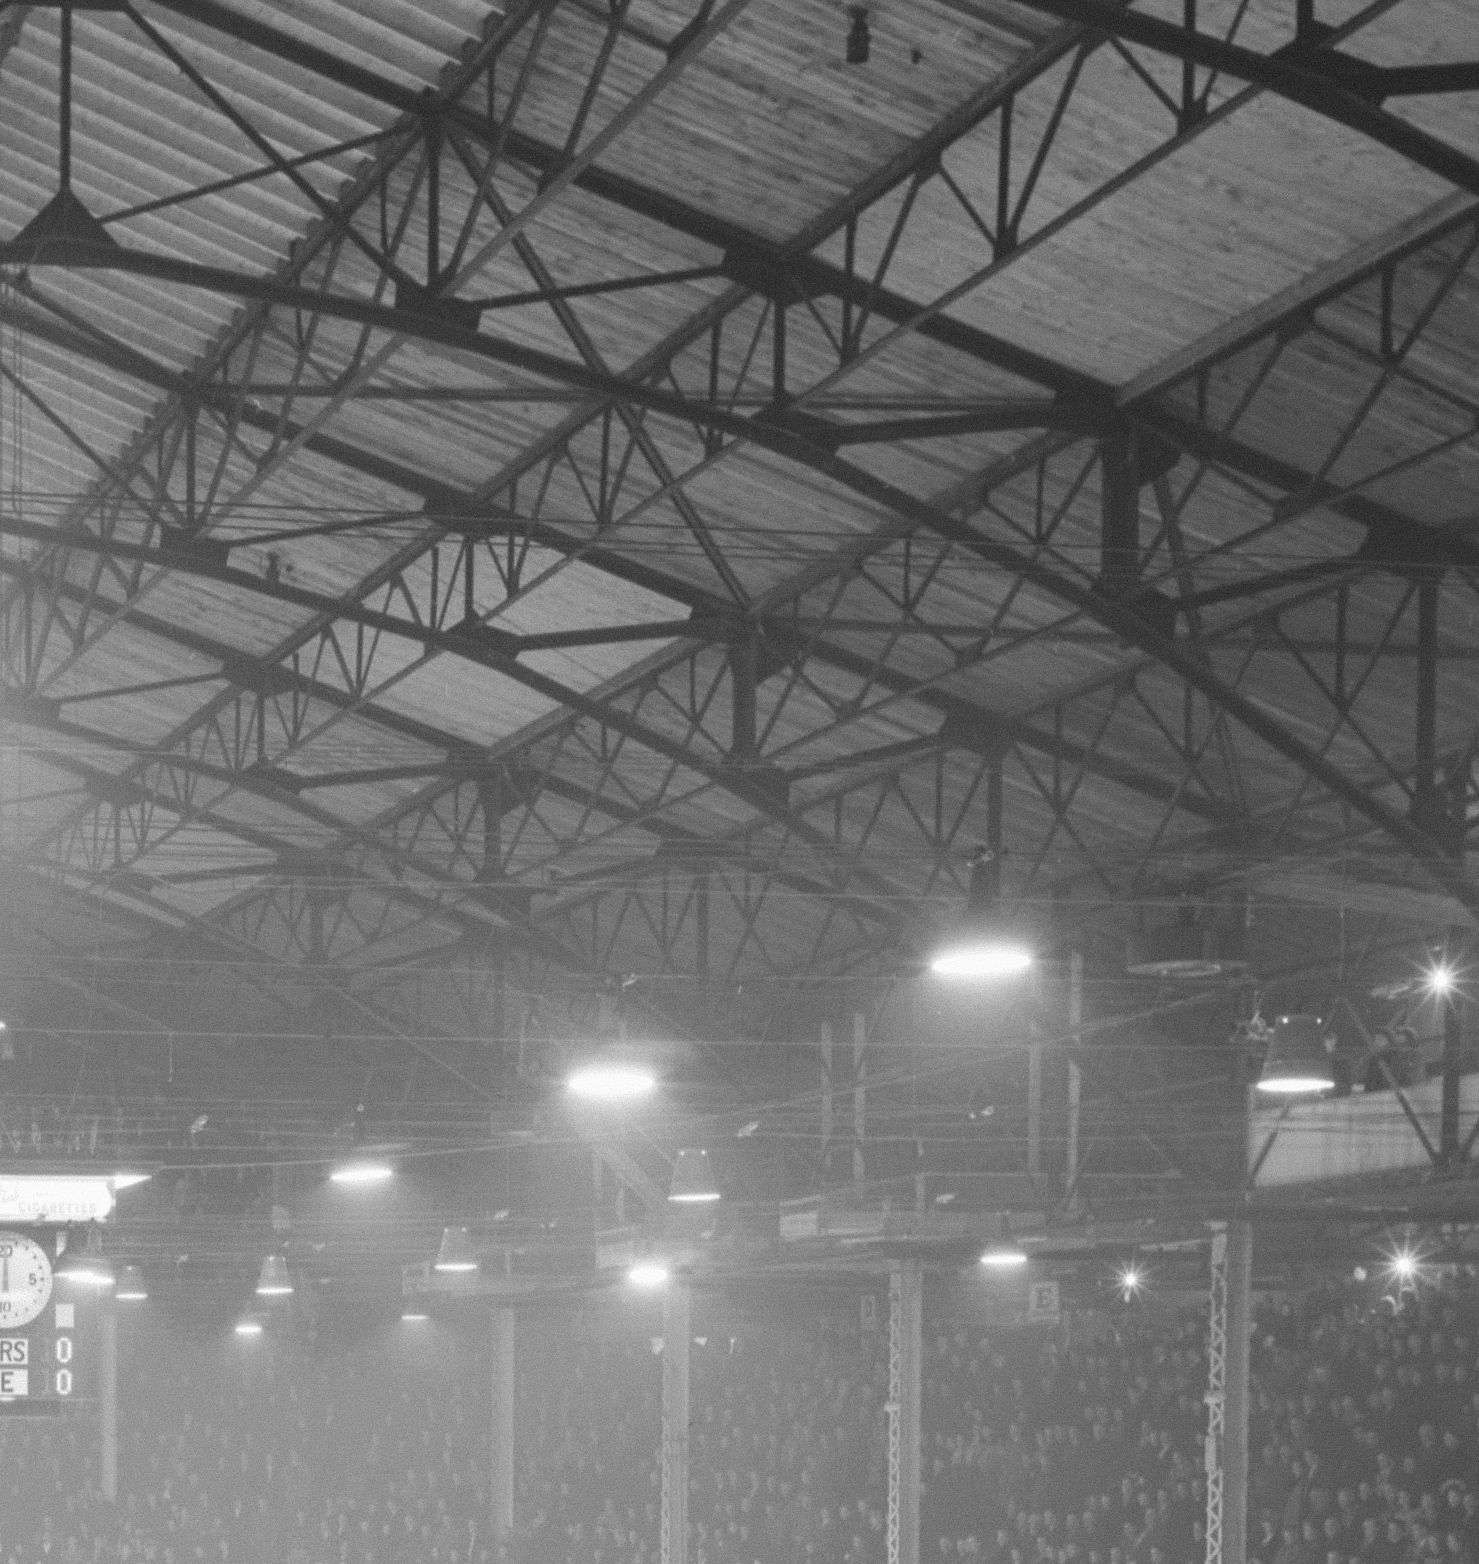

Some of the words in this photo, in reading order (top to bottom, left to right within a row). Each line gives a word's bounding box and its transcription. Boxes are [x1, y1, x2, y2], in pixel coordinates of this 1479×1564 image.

[29, 1273, 38, 1286] 5
[0, 1302, 12, 1313] 10
[1035, 1286, 1053, 1308] E
[56, 1338, 72, 1364] 0
[56, 1370, 72, 1396] 0
